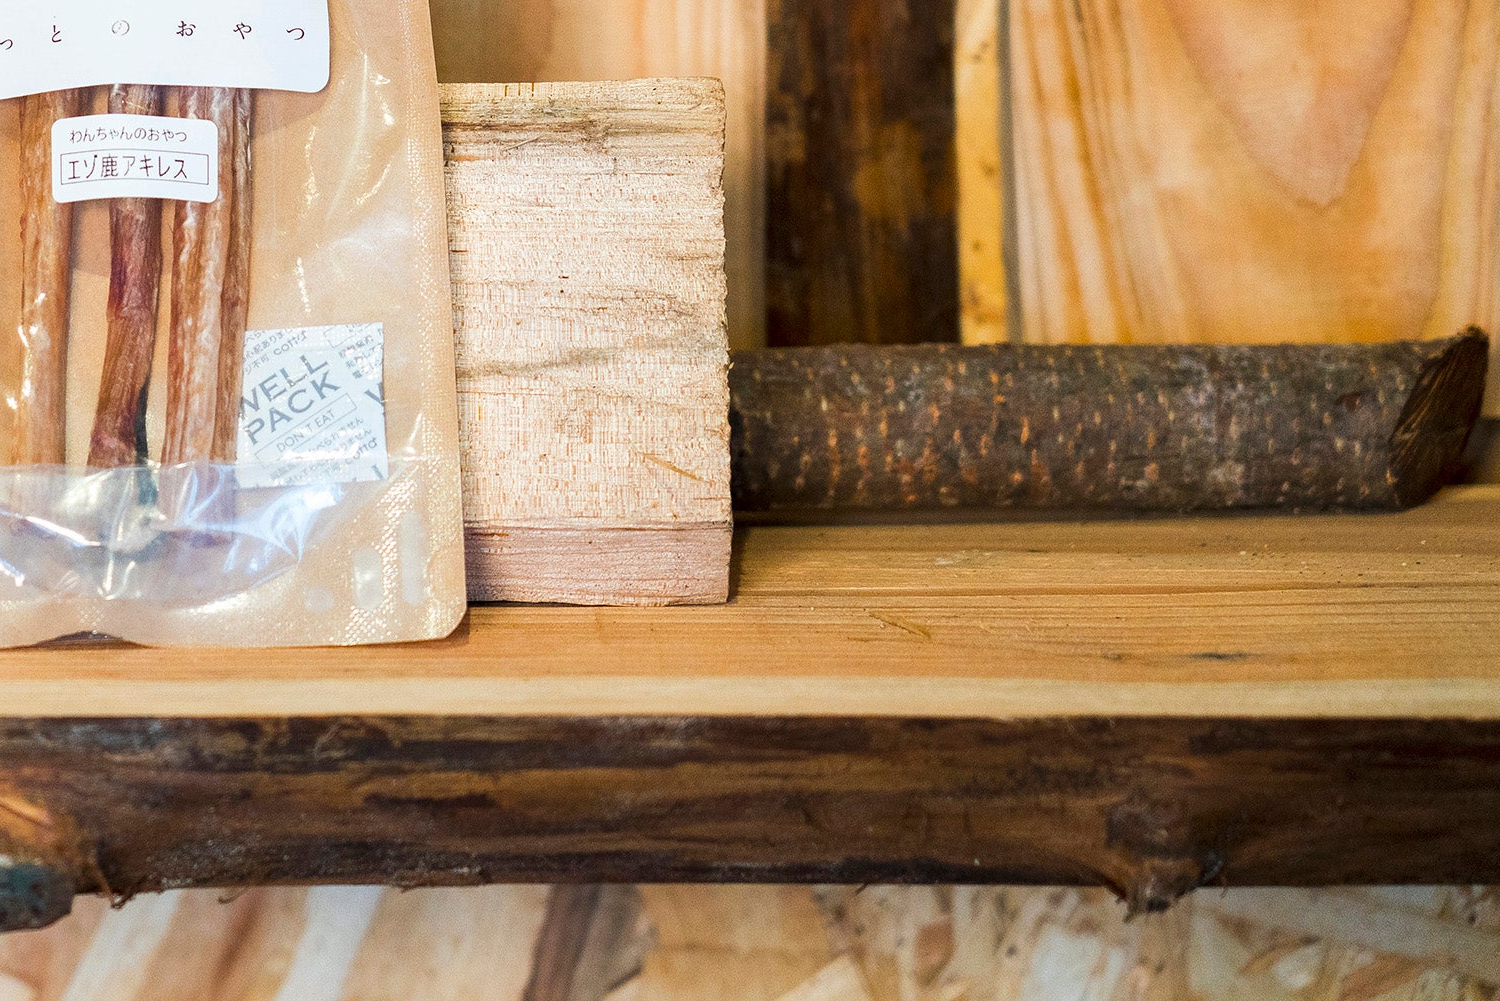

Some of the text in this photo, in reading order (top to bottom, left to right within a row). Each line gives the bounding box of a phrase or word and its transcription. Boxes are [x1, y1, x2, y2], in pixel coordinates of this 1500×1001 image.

[69, 126, 188, 144] わんちゃんのおやつ
[67, 153, 188, 180] エゾ鹿アキレス
[238, 355, 329, 420] WELL
[243, 370, 341, 446] PACK
[276, 422, 315, 453] DONT
[315, 408, 336, 429] EAT
